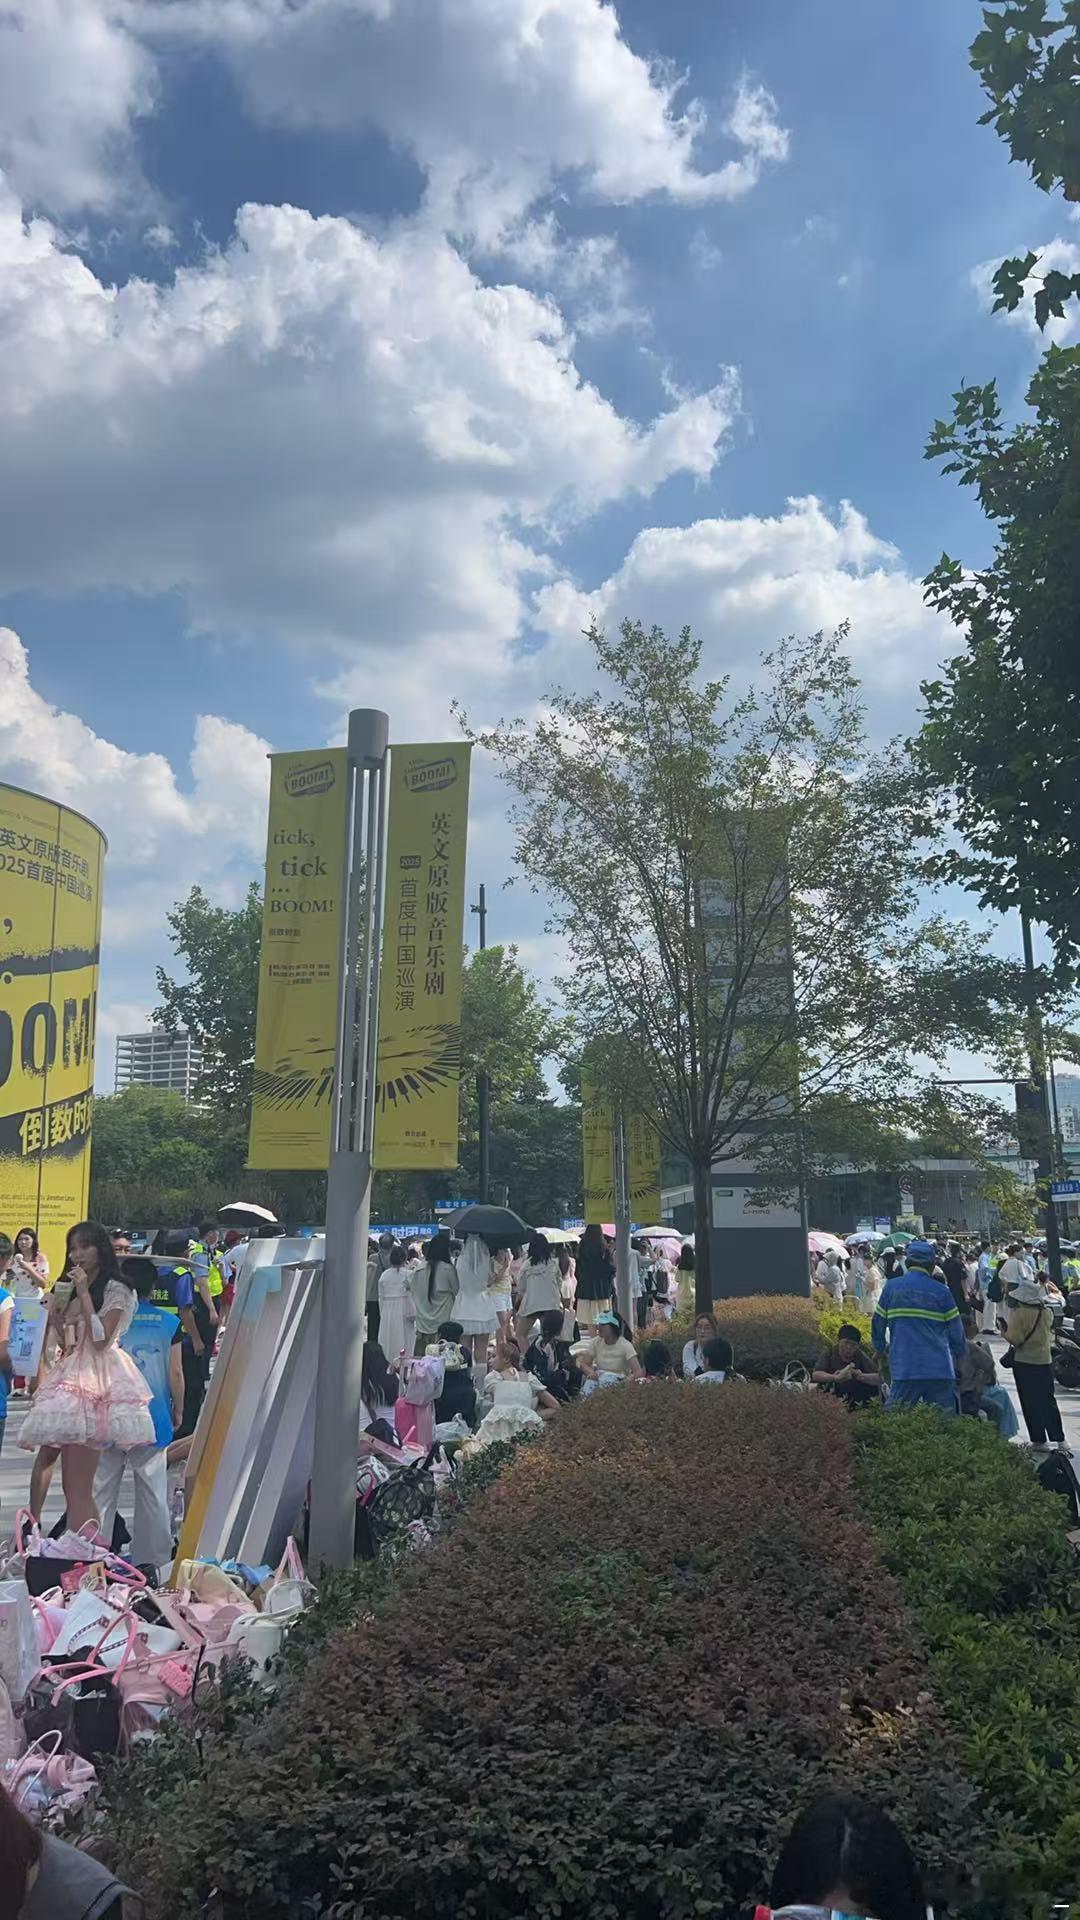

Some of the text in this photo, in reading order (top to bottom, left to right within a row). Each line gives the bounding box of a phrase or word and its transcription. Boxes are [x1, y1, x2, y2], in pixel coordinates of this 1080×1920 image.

[291, 768, 329, 790] BOOM!
[411, 764, 450, 786] BOOM!
[273, 828, 316, 847] tick,
[280, 855, 328, 877] tick
[270, 899, 334, 914] BOOM!
[423, 812, 452, 996] 英文原版音乐剧
[394, 878, 419, 1011] 首度中国巡演
